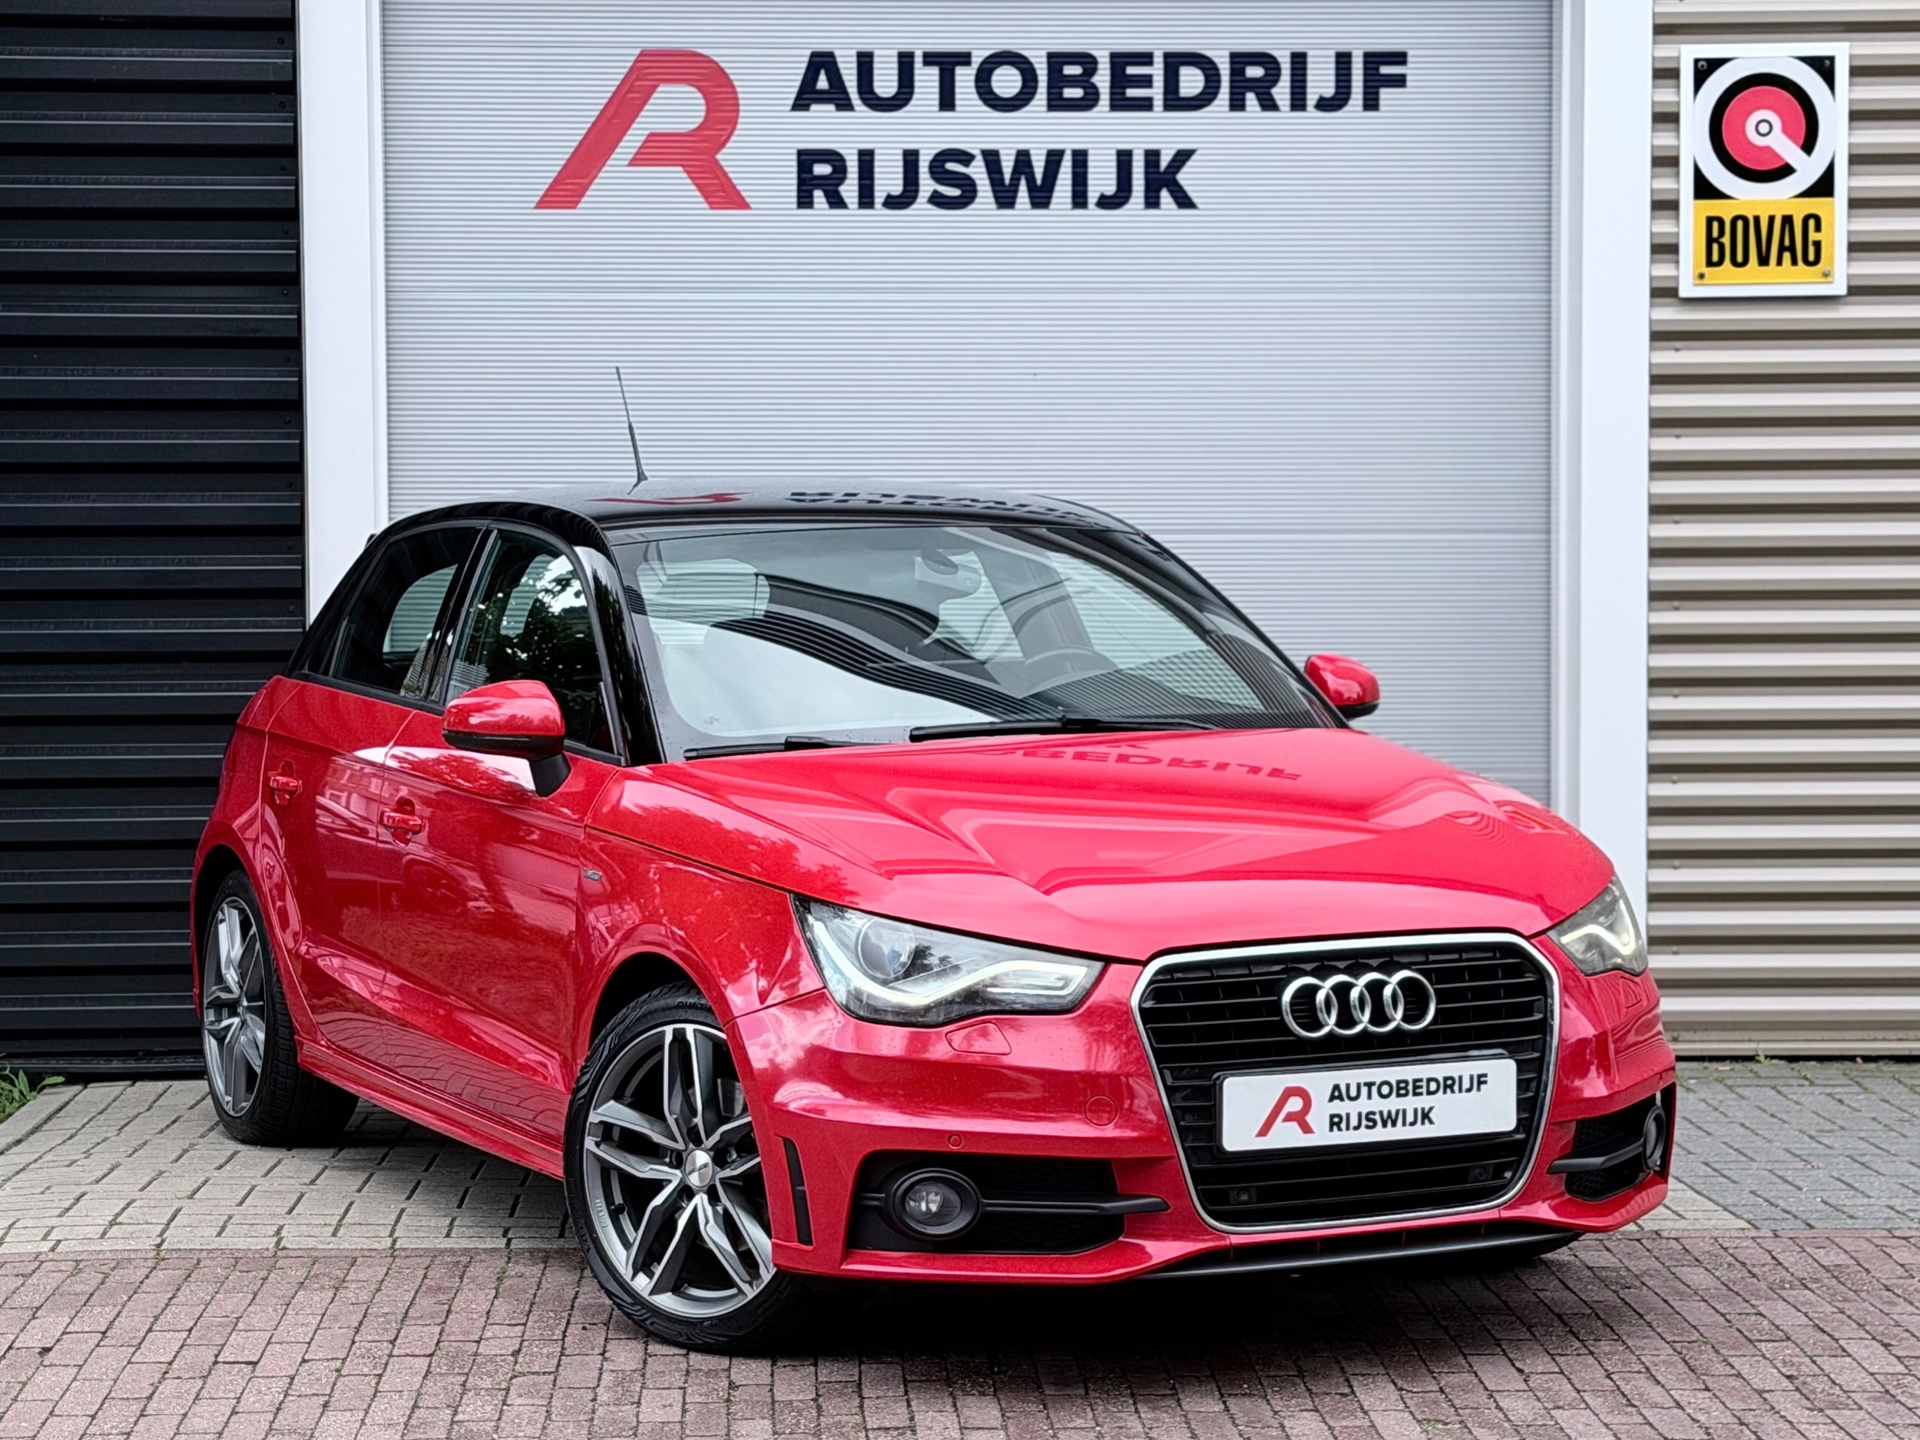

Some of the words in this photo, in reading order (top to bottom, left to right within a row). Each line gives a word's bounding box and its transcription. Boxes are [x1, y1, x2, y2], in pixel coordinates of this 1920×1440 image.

[791, 50, 1409, 113] AUTOBEDRIJF
[796, 148, 1199, 211] RIJSWIJK
[1705, 213, 1822, 269] BOVAG
[1328, 1073, 1489, 1104] AUTOBEDRIJF
[1328, 1106, 1436, 1133] RIJSWIJK
